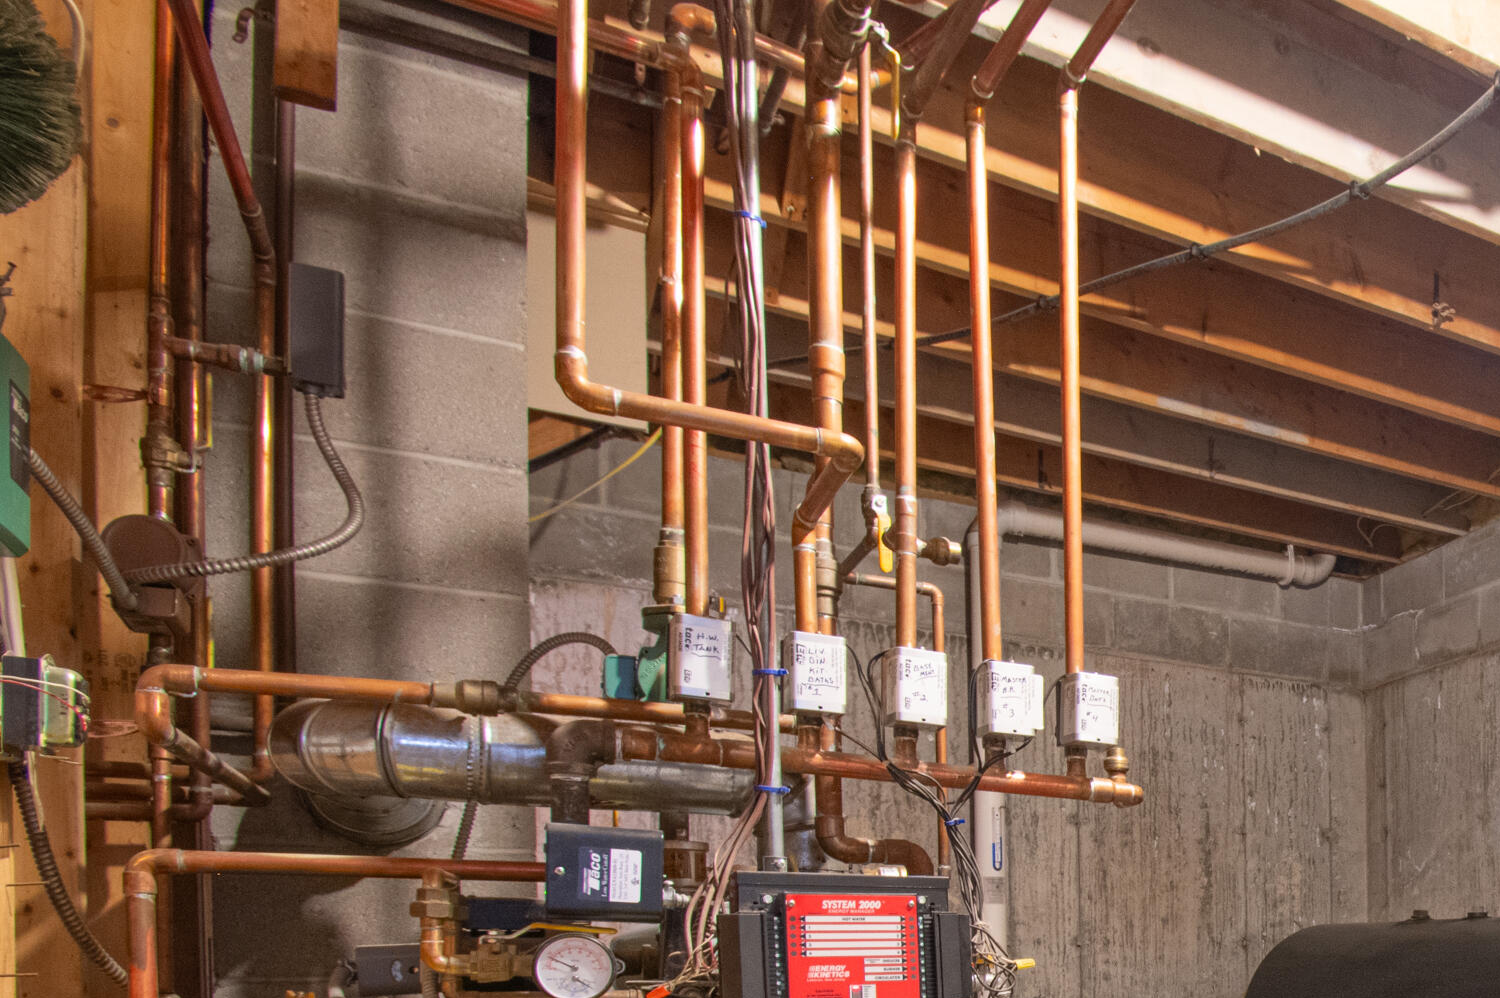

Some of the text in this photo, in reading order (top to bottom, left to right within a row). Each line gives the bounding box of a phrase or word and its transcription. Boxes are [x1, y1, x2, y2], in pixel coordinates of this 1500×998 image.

[694, 644, 720, 653] TANK
[582, 853, 601, 896] Taco
[822, 900, 882, 909] SYSTEM 2000
